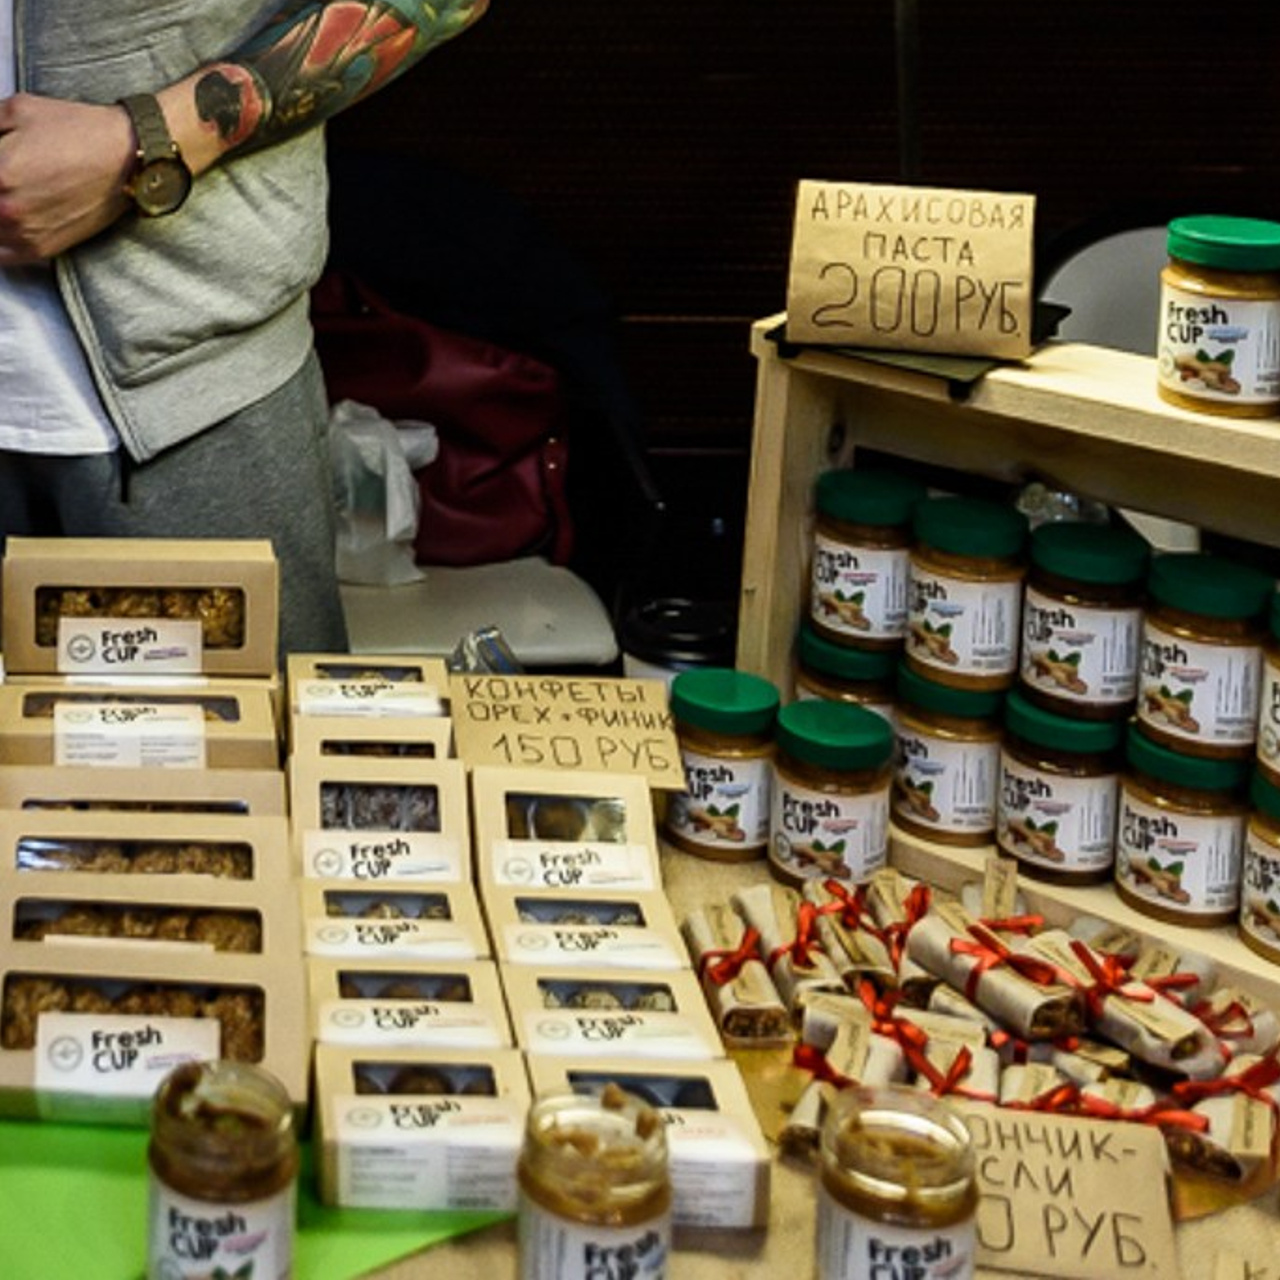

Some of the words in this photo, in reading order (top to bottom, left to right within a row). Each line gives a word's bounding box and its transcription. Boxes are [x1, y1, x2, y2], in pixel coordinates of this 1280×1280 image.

[811, 189, 1025, 230] АРАХИСОВАЯ
[863, 230, 975, 266] ПАСТА
[811, 262, 940, 338] 200
[1169, 301, 1229, 325] Fresh
[1167, 324, 1204, 344] CUP
[101, 627, 158, 646] Fresh
[101, 646, 139, 664] CUP
[464, 677, 646, 703] КОНФЕТЫ
[492, 732, 583, 768] 150
[687, 781, 714, 801] UP
[782, 791, 840, 818] Fresh
[782, 813, 819, 835] CUP
[350, 838, 410, 861] Fresh
[539, 848, 602, 870] Fresh
[352, 860, 392, 879] CUP
[542, 870, 583, 887] CUP
[91, 1024, 163, 1050] Fresh
[92, 1048, 139, 1074] CUP
[867, 1234, 952, 1266] Fresh
